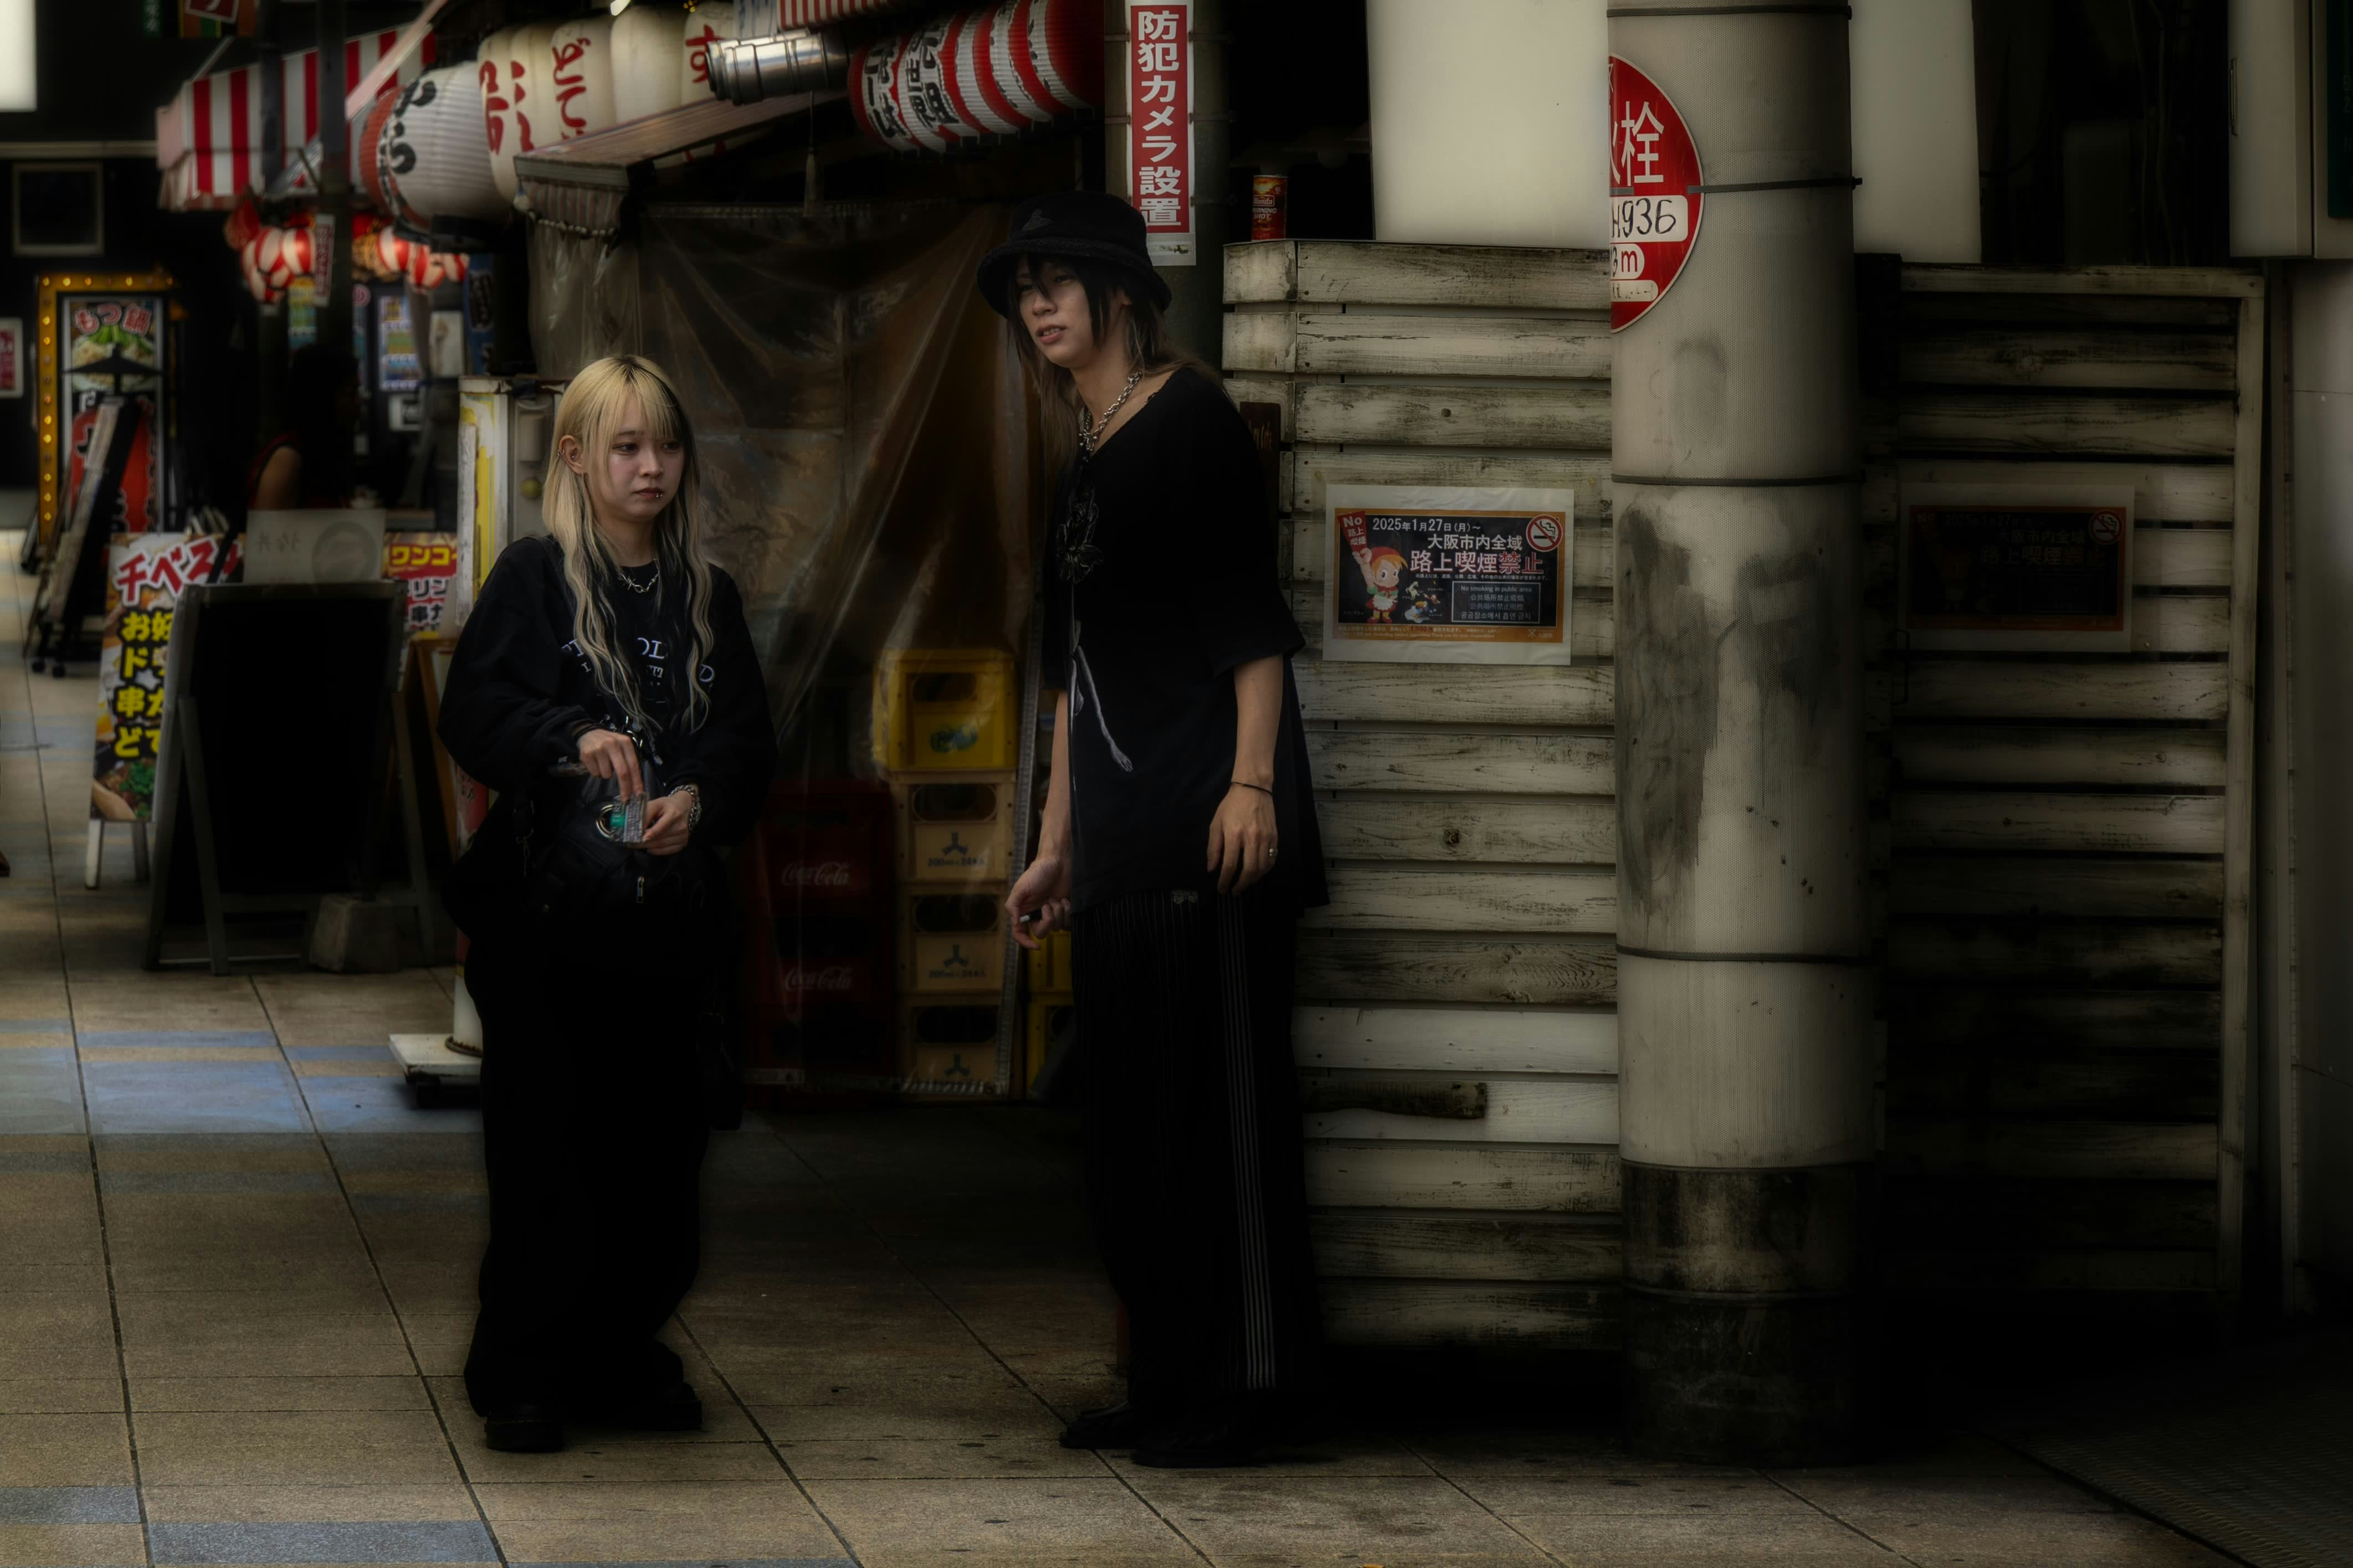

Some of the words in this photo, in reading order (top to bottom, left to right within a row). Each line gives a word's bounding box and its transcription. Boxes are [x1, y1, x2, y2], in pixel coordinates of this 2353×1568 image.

[1137, 10, 1182, 227] 防犯カメラ設置
[1343, 516, 1363, 528] No
[1427, 533, 1523, 550] 大阪市内全域
[1409, 550, 1544, 574] 路上喫煙禁止
